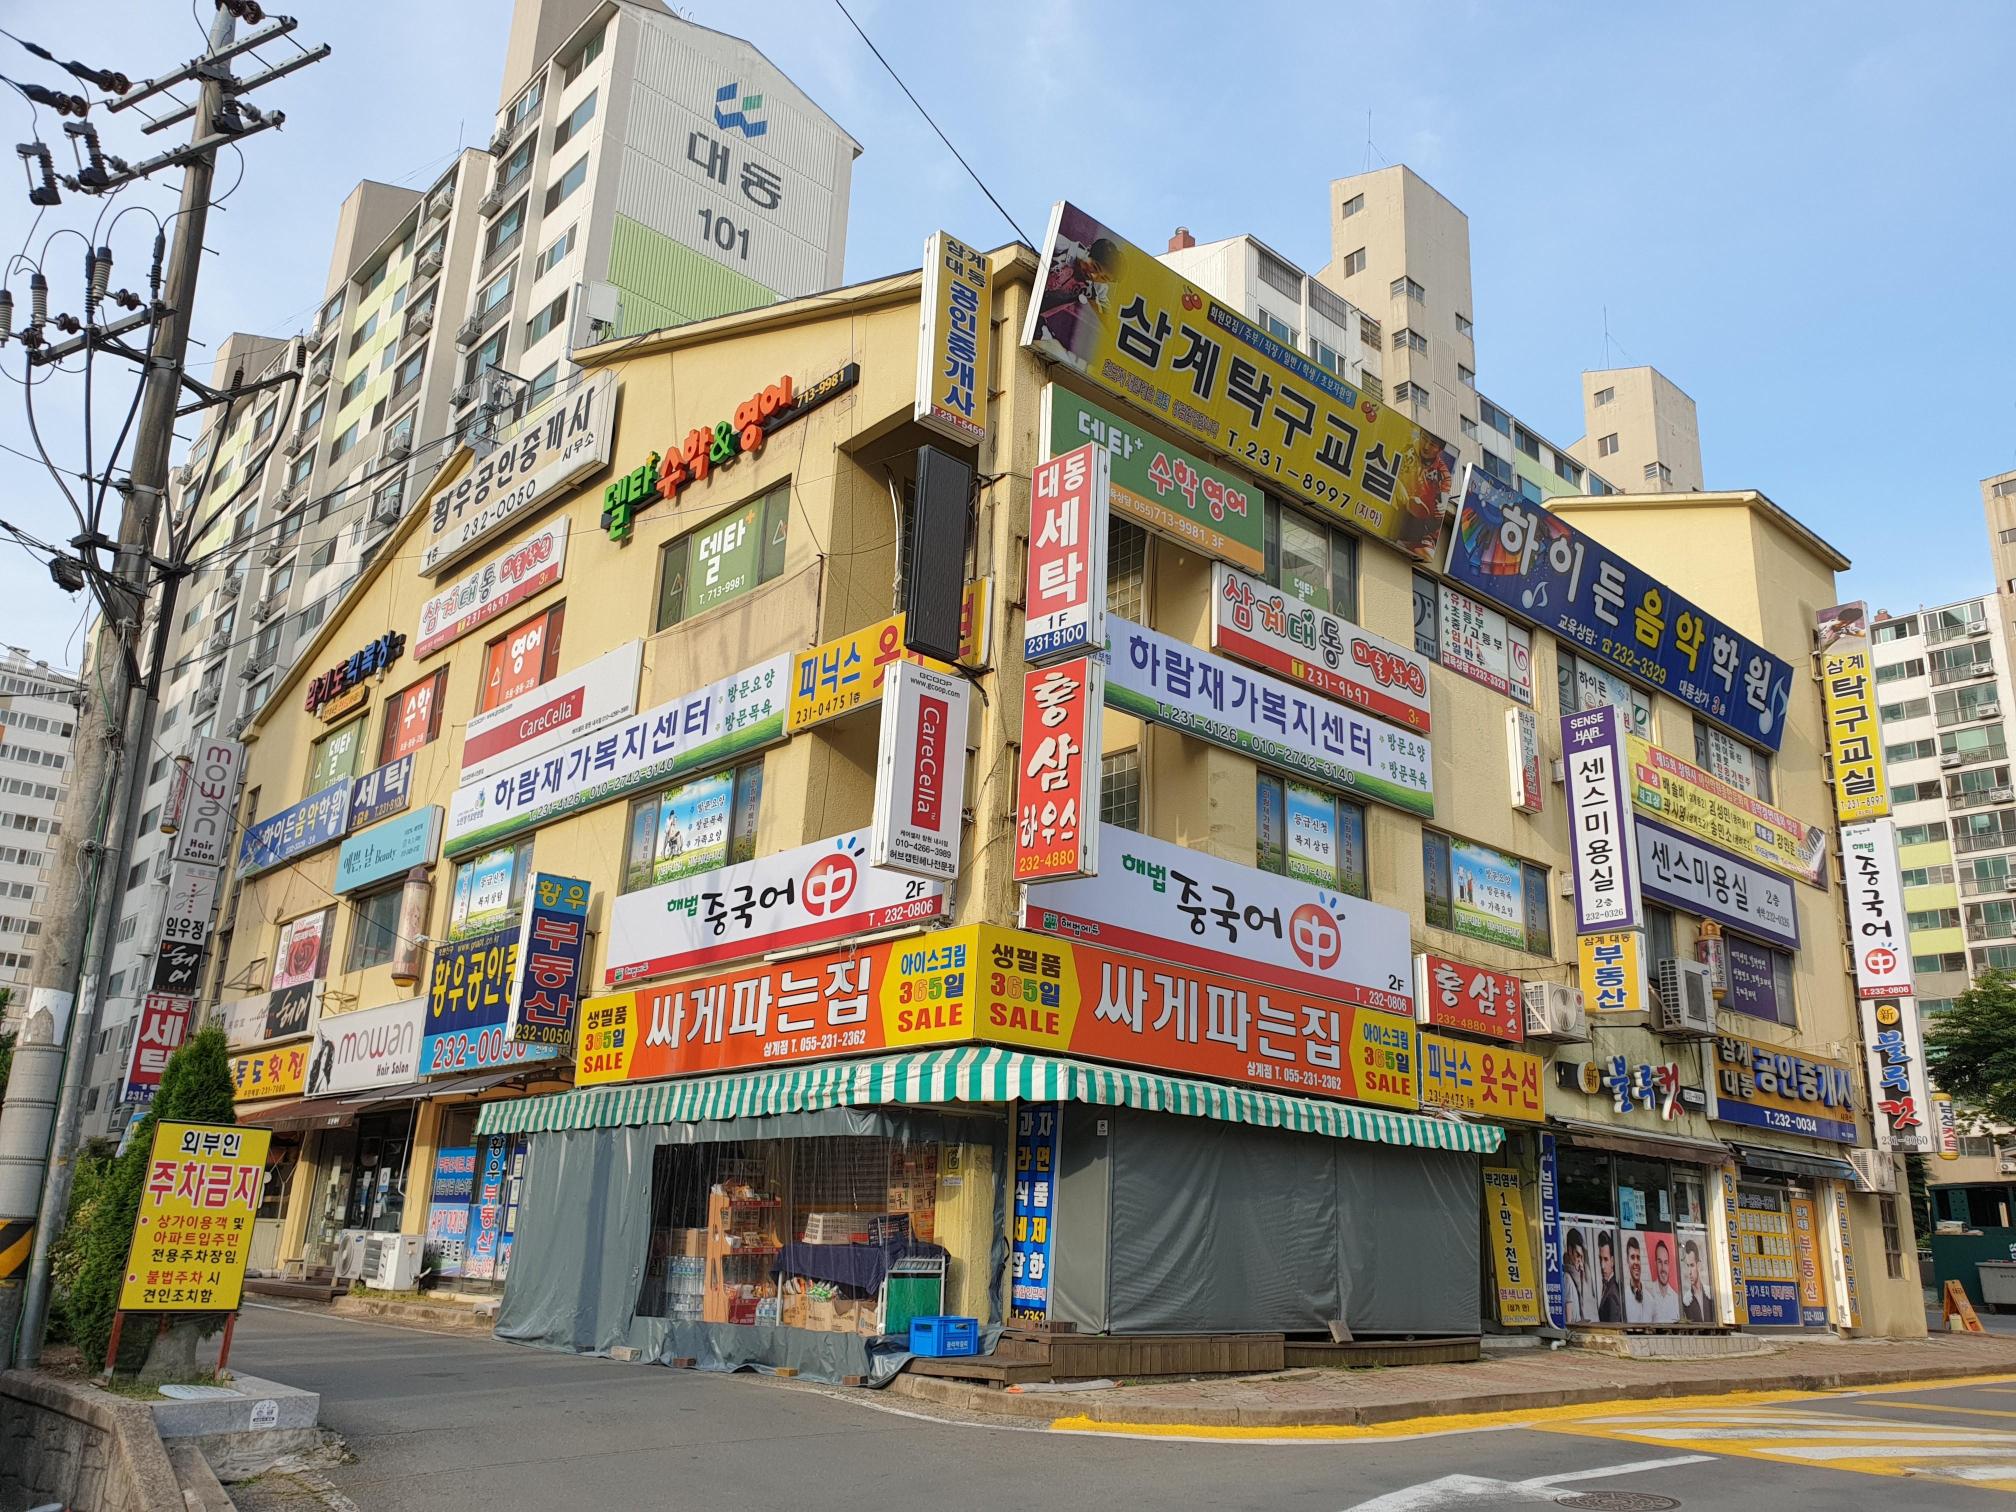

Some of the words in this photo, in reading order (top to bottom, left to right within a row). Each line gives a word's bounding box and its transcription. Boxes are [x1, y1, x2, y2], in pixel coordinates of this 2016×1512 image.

[687, 130, 782, 211] 대동
[698, 208, 750, 260] 101
[945, 240, 987, 271] 삼계
[945, 256, 986, 288] 대동
[1210, 306, 1240, 332] 회원모집
[944, 280, 980, 417] 공인중개사
[796, 370, 846, 408] 713-9981
[1115, 293, 1402, 505] 삼계탁구교실
[1038, 452, 1087, 498] 대동
[1226, 430, 1351, 510] T.231-8997
[1353, 501, 1383, 528] (지하)
[462, 479, 536, 543] 232-0050
[1035, 496, 1082, 603] 세탁
[1211, 535, 1224, 549] 3F
[1048, 613, 1067, 630] 1F
[1500, 503, 1772, 711] 하이든음악학원
[511, 625, 543, 674] 영어
[1028, 624, 1085, 654] 231-8100
[1222, 573, 1344, 670] 삼계대동
[1351, 637, 1427, 698] 미술학원
[799, 642, 861, 701] 피닉스
[1612, 644, 1667, 685] 232-3329
[1826, 655, 1865, 675] 삼계
[727, 669, 776, 703] 방문요양
[910, 677, 961, 699] www.gcoop.com
[1129, 635, 1372, 766] 하람재가복지센터
[1307, 667, 1370, 706] 231-9697
[519, 701, 572, 740] CareCella
[724, 699, 773, 731] 방문목욕
[795, 696, 845, 725] 231-0475
[1570, 712, 1604, 729] SENSE
[1027, 671, 1080, 793] 홍삼
[1574, 727, 1603, 746] HAIR
[1832, 674, 1876, 796] 탁구교실
[494, 697, 712, 809] 하람재가복지센터
[918, 706, 940, 813] CareCella
[1251, 736, 1356, 784] 010-2742-3140
[1386, 733, 1426, 763] 방문요양
[355, 757, 409, 808] 세탁
[1388, 761, 1428, 790] 방문목욕
[194, 746, 232, 837] mowan
[1020, 801, 1077, 849] 하우스
[1579, 757, 1615, 893] 센스미용실
[184, 848, 215, 862] Salon
[189, 839, 214, 851] Hair
[895, 838, 951, 859] 010-4266-3989
[1294, 834, 1329, 854] 복지상담
[1852, 841, 1875, 853] 해법
[1019, 852, 1075, 873] 232-4880
[1651, 839, 1749, 912] 센스미용실
[536, 880, 588, 909] 황우
[905, 880, 926, 900] 2F
[1121, 853, 1166, 893] 해법
[1171, 869, 1283, 944] 중국어
[1855, 854, 1893, 938] 중국어
[667, 893, 699, 918] 해법
[702, 877, 795, 936] 중국어
[884, 900, 934, 925] 232-0806
[1585, 908, 1624, 921] 232-0326
[165, 917, 205, 941] 임우정
[1060, 915, 1100, 936] 해법에듀
[1583, 935, 1605, 946] 삼계
[1609, 934, 1631, 945] 대동
[524, 916, 579, 1025] 부동산
[900, 943, 966, 976] 아이스크림
[991, 942, 1062, 979] 생필품
[899, 972, 965, 1005] 365일
[990, 972, 1060, 1008] 365일
[1388, 974, 1404, 991] 2F
[1433, 963, 1500, 1016] 홍삼
[1593, 944, 1628, 1010] 부동산
[1862, 985, 1910, 997] T.232-0806
[149, 998, 190, 1013] 대동
[586, 1004, 628, 1028] 생필품
[645, 956, 872, 1050] 싸게파는집
[1094, 962, 1341, 1070] 싸게파는집
[1369, 989, 1407, 1012] 232-0806
[1504, 979, 1518, 1034] 하우스
[1879, 1007, 1894, 1023] 新
[897, 1003, 964, 1032] SALE
[989, 1002, 1061, 1036] SALE
[1437, 1012, 1487, 1033] 232-4880
[338, 1020, 413, 1064] mowan
[431, 1028, 528, 1069] 232-0050
[515, 1025, 570, 1044] 232-0050
[584, 1027, 626, 1051] 365일
[763, 1041, 789, 1058] 삼계점
[799, 1031, 865, 1052] 055-231-2362
[1362, 1022, 1409, 1051] 아이스크림
[583, 1052, 623, 1073] SALE
[1364, 1045, 1410, 1074] 365일
[1720, 1036, 1750, 1067] 삼계
[377, 1063, 389, 1077] Hair
[392, 1062, 409, 1074] Salon
[1246, 1059, 1273, 1079] 삼계점
[1283, 1067, 1342, 1091] 055-231-2362
[1366, 1070, 1411, 1096] SALE
[1427, 1044, 1473, 1089] 피닉스
[1481, 1053, 1539, 1110] 옷수선
[1722, 1069, 1754, 1098] 대동
[1753, 1048, 1853, 1110] 공인중개사
[1019, 1112, 1053, 1137] 과자
[1764, 1110, 1817, 1132] T.232-0034
[182, 1130, 241, 1157] 외부인
[485, 1136, 506, 1181] 황우
[1016, 1146, 1050, 1172] 라면
[149, 1161, 261, 1210] 주차금지
[1015, 1181, 1049, 1208] 식품
[1484, 1171, 1519, 1188] 뿌리염색
[158, 1215, 228, 1230] 상가이용객
[234, 1217, 244, 1230] 및
[476, 1183, 498, 1253] 부동산
[1013, 1216, 1047, 1244] 세제
[153, 1231, 239, 1247] 아파트입주민
[1499, 1192, 1521, 1283] 1만5천원
[151, 1249, 239, 1264] 전용주차장임.
[1011, 1251, 1045, 1280] 잡화
[1799, 1235, 1818, 1301] 부동산
[146, 1270, 203, 1285] 불법주차
[207, 1271, 220, 1285] 시
[142, 1289, 217, 1303] 견인조치함.
